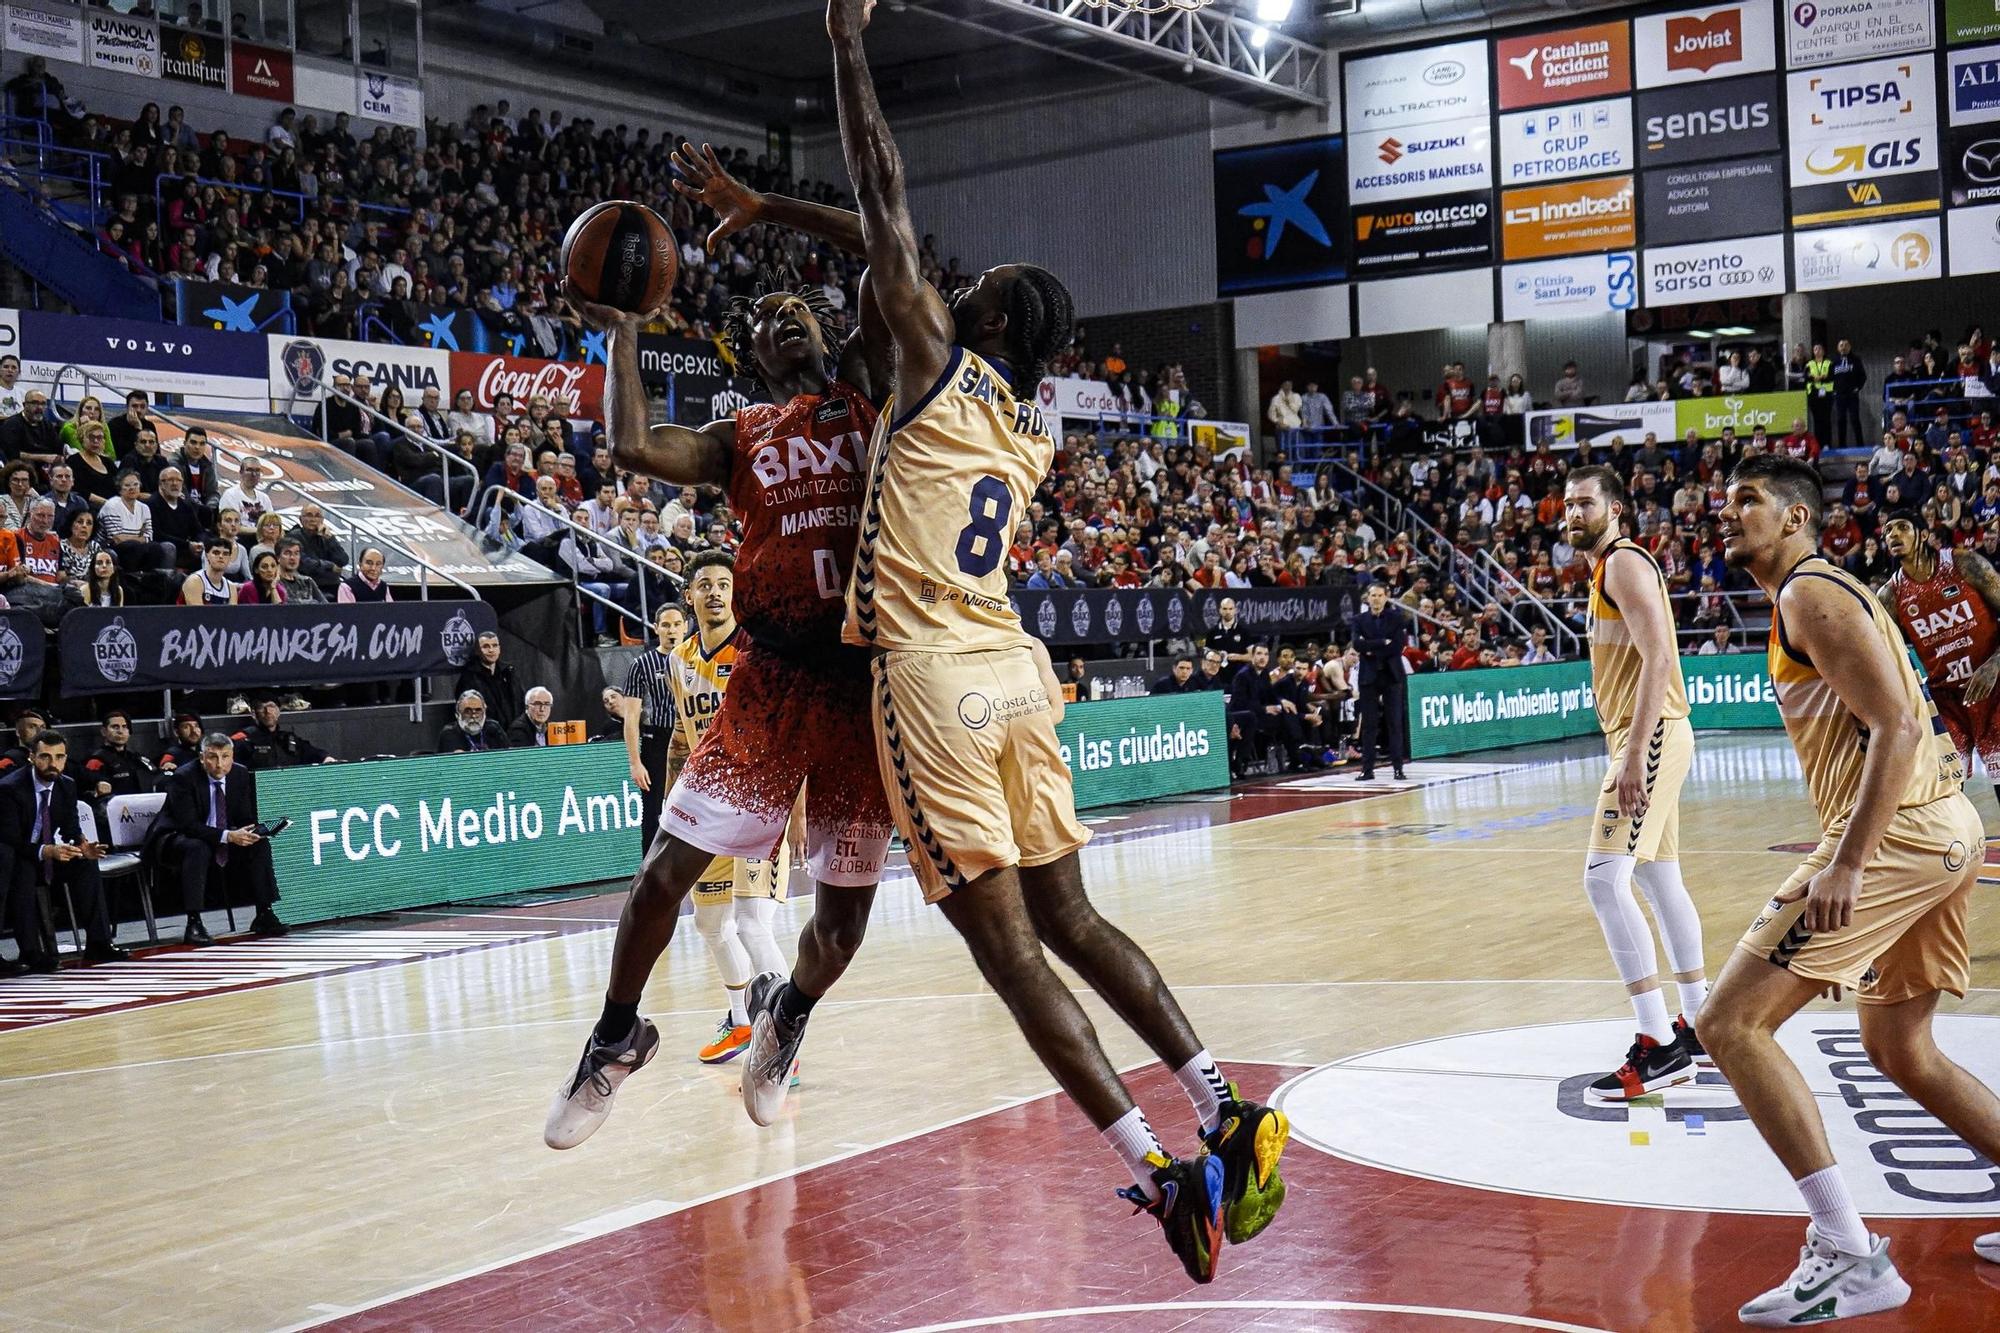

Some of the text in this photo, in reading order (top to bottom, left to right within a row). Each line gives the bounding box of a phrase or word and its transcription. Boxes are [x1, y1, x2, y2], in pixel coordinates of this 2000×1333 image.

[1820, 2, 1873, 18] PORXADA
[92, 18, 155, 42] JUANOLA
[1812, 14, 1902, 36] APARQUI EN EL
[1674, 31, 1732, 54] Joviat
[1797, 23, 1923, 50] CENTRE DE MANRESA
[96, 52, 134, 65] expert
[1541, 40, 1609, 61] Catalana
[161, 51, 226, 83] frankfurt
[1542, 55, 1609, 77] Occident
[1959, 64, 2000, 88] AL
[246, 74, 280, 88] montepio
[1543, 70, 1609, 88] Assegurances
[1821, 81, 1901, 110] TIPSA
[364, 100, 391, 114] CEM
[1364, 96, 1468, 118] FULL TRACTION
[1646, 102, 1770, 142] sensus
[1407, 136, 1465, 154] SUZUKI
[1543, 135, 1589, 155] GRUP
[1867, 137, 1921, 169] GLS
[1513, 150, 1621, 177] PETROBAGES
[1355, 163, 1484, 190] ACCESSORIS MANRESA
[1667, 164, 1773, 186] CONSULTORIA EMPRESARIAL
[1667, 187, 1709, 201] ADVOCATS
[1542, 190, 1631, 221] innaltech
[1668, 202, 1710, 215] AUDITORIA
[1543, 224, 1632, 241] www.innaltech.com
[1654, 254, 1743, 277] movento
[1803, 265, 1841, 278] SPORT
[1534, 285, 1597, 300] Sant Josep
[1655, 275, 1712, 293] sarsa
[106, 337, 193, 356] VOLVO
[332, 358, 440, 389] SCANIA
[640, 349, 722, 377] mecexis
[1099, 396, 1113, 410] de
[1706, 405, 1777, 430] brot d'or
[752, 431, 868, 489] BAXI
[764, 477, 867, 507] CLIMATIZACIÓ
[781, 504, 861, 537] MANRESA
[955, 474, 1013, 579] 8
[962, 591, 1003, 612] Murcia
[1910, 600, 1974, 639] BAXI
[159, 622, 424, 670] BAXIMANRESA.COM
[443, 632, 475, 648] BAXI
[97, 643, 136, 660] BAXI
[992, 696, 1028, 712] Costa
[1421, 681, 1594, 729] FCC Medio Ambiente por la
[1078, 732, 1113, 771] las
[1119, 721, 1210, 767] ciudades
[309, 802, 402, 867] FCC
[418, 790, 544, 853] Medio
[835, 839, 860, 858] ETL
[829, 858, 879, 874] GLOBAL
